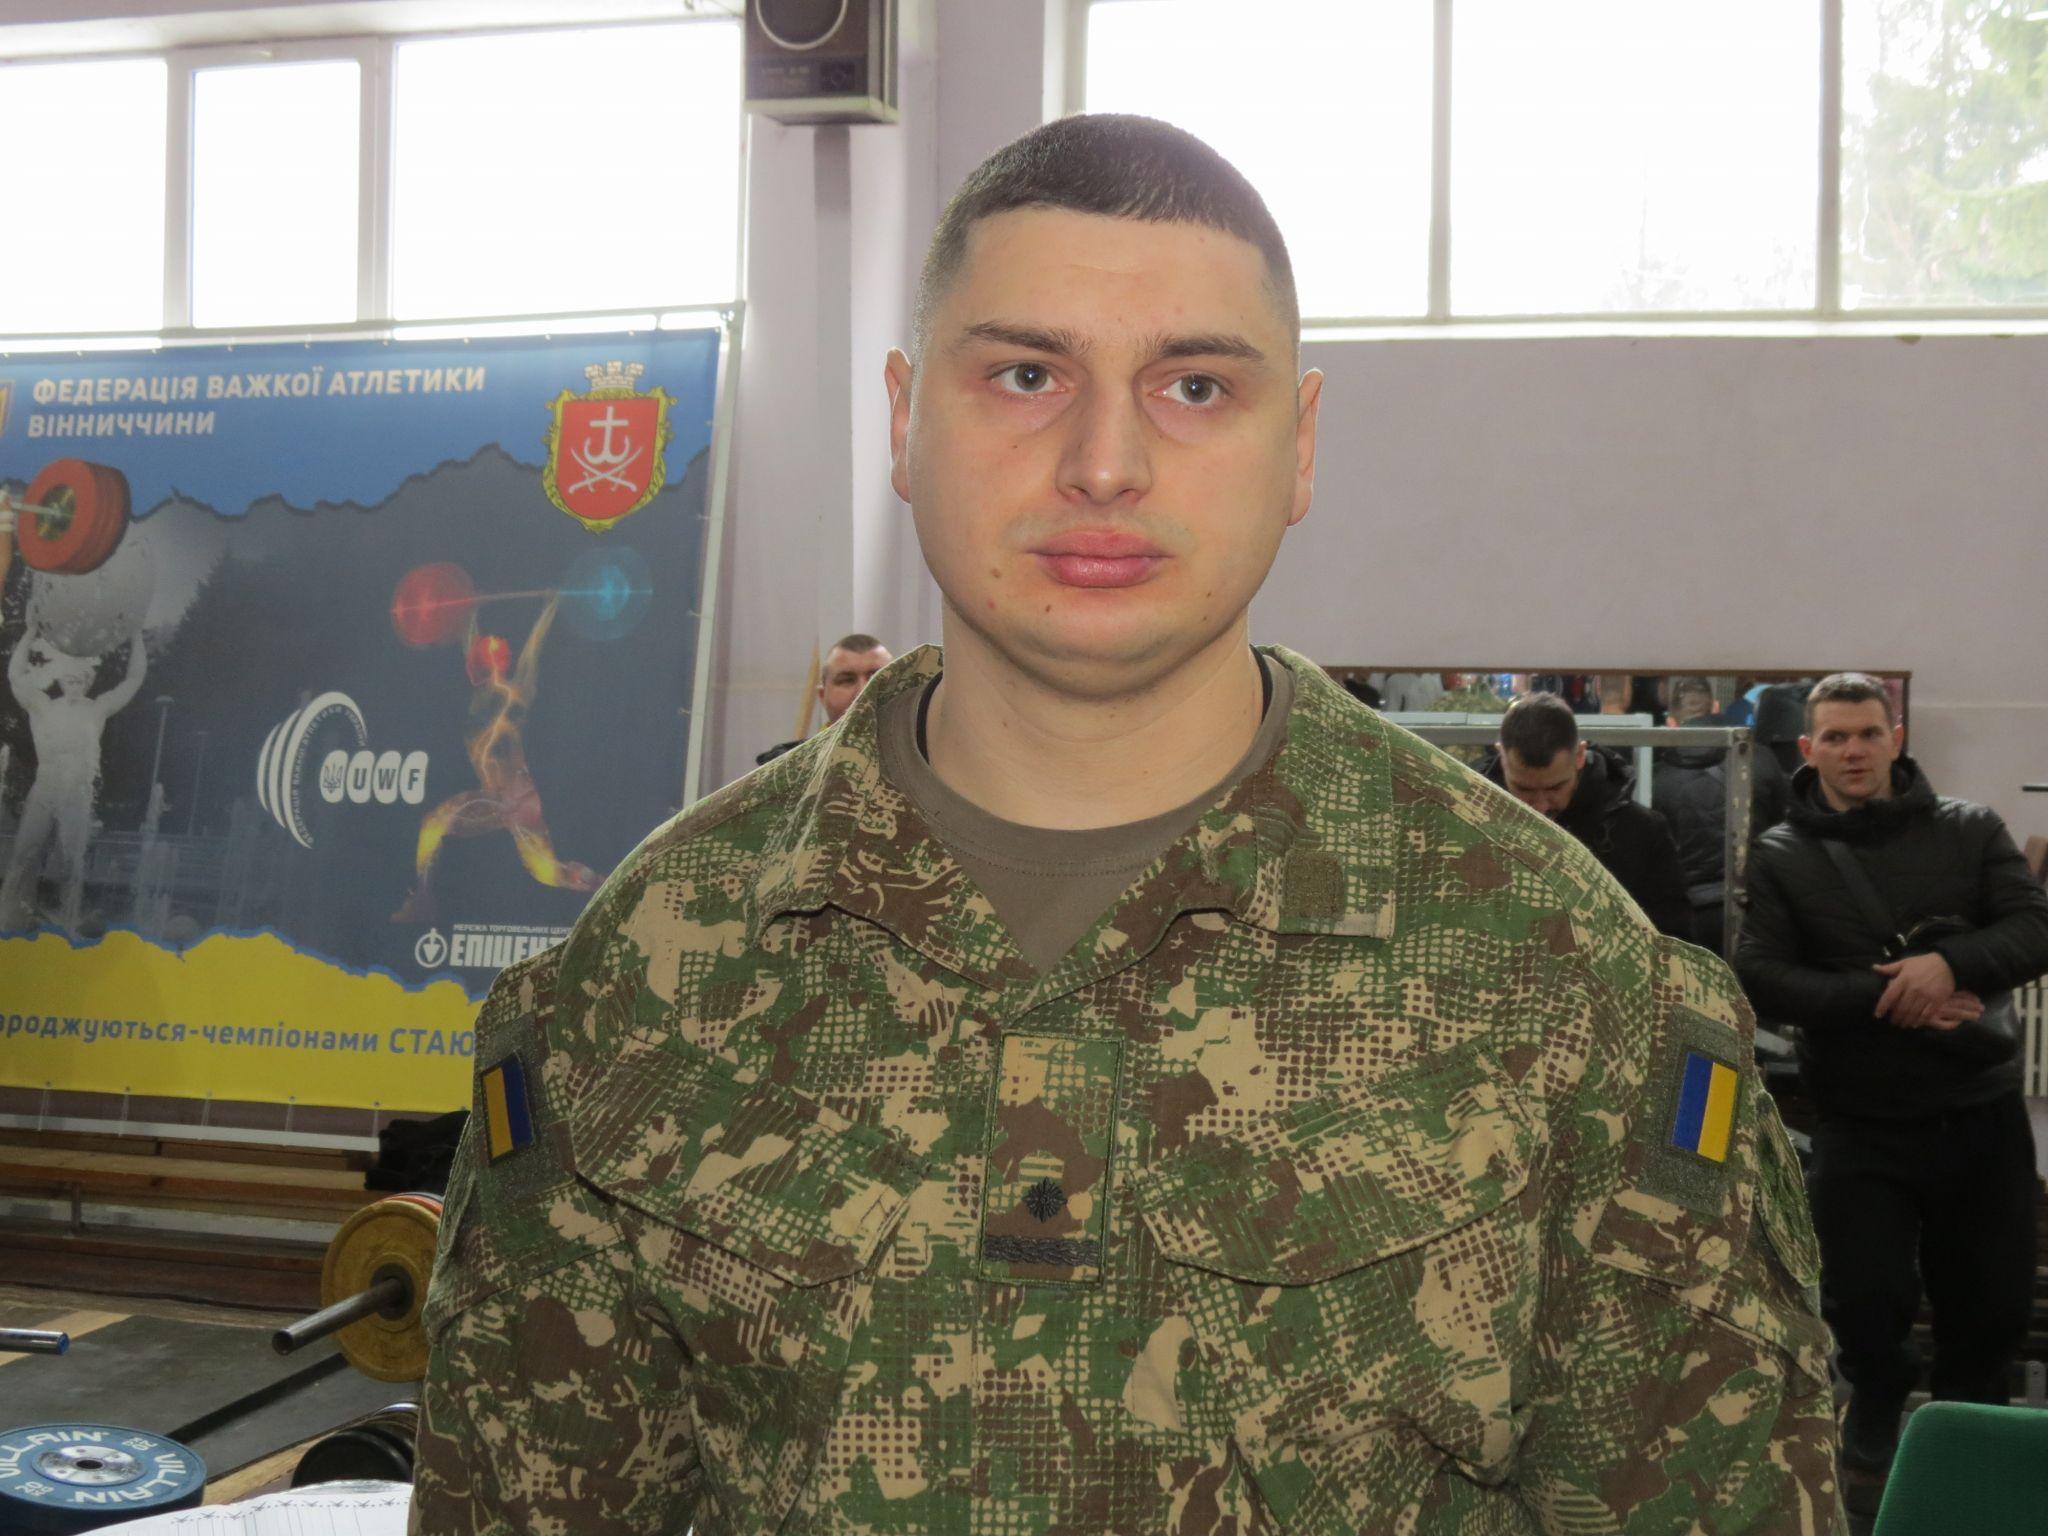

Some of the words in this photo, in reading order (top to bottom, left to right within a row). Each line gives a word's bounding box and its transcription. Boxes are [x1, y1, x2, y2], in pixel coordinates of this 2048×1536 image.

[33, 376, 198, 406] ФЕДЕРАЦІЯ
[206, 365, 325, 399] ВАЖКОЇ
[327, 367, 486, 396] АТЛЕТИКИ
[27, 411, 216, 438] ВІННИЧЧИНИ
[449, 934, 570, 968] ЕПІЦЕН
[389, 1027, 475, 1057] СТАЮ
[0, 1430, 105, 1479] VILLAIN
[75, 1453, 187, 1504] VILLAIN
